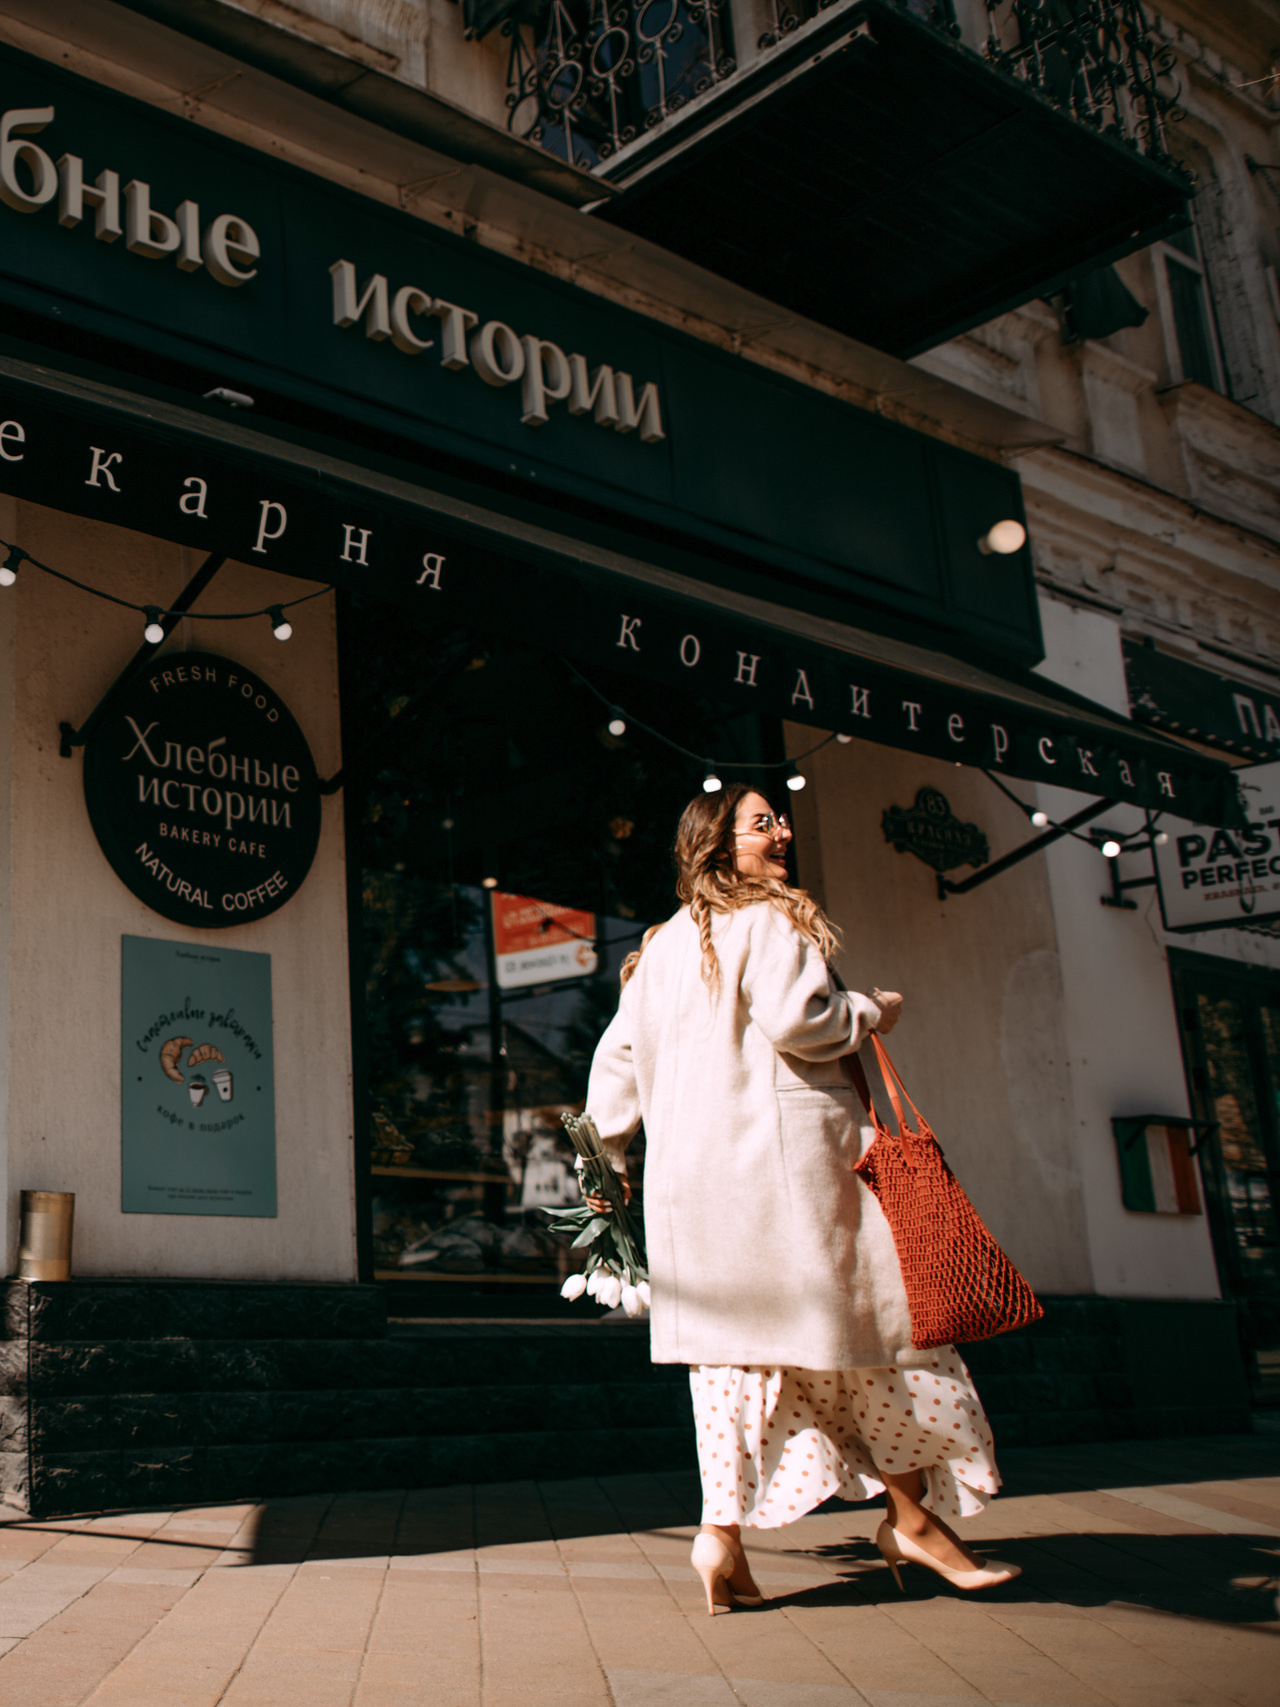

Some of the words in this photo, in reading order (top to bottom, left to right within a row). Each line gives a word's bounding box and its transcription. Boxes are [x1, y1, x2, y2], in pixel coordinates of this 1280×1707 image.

[328, 257, 666, 444] истории
[149, 665, 217, 693] FRESH
[228, 675, 280, 723] FOOD
[616, 613, 1177, 799] кондитерская
[122, 715, 300, 792] Хлебные
[138, 774, 292, 831] истории
[159, 822, 221, 848] BAKERY
[228, 837, 267, 858] CAFE
[135, 842, 214, 909] NATURAL
[222, 870, 289, 912] COFFEE
[156, 1104, 184, 1127] кофе
[200, 1112, 245, 1133] подарок
